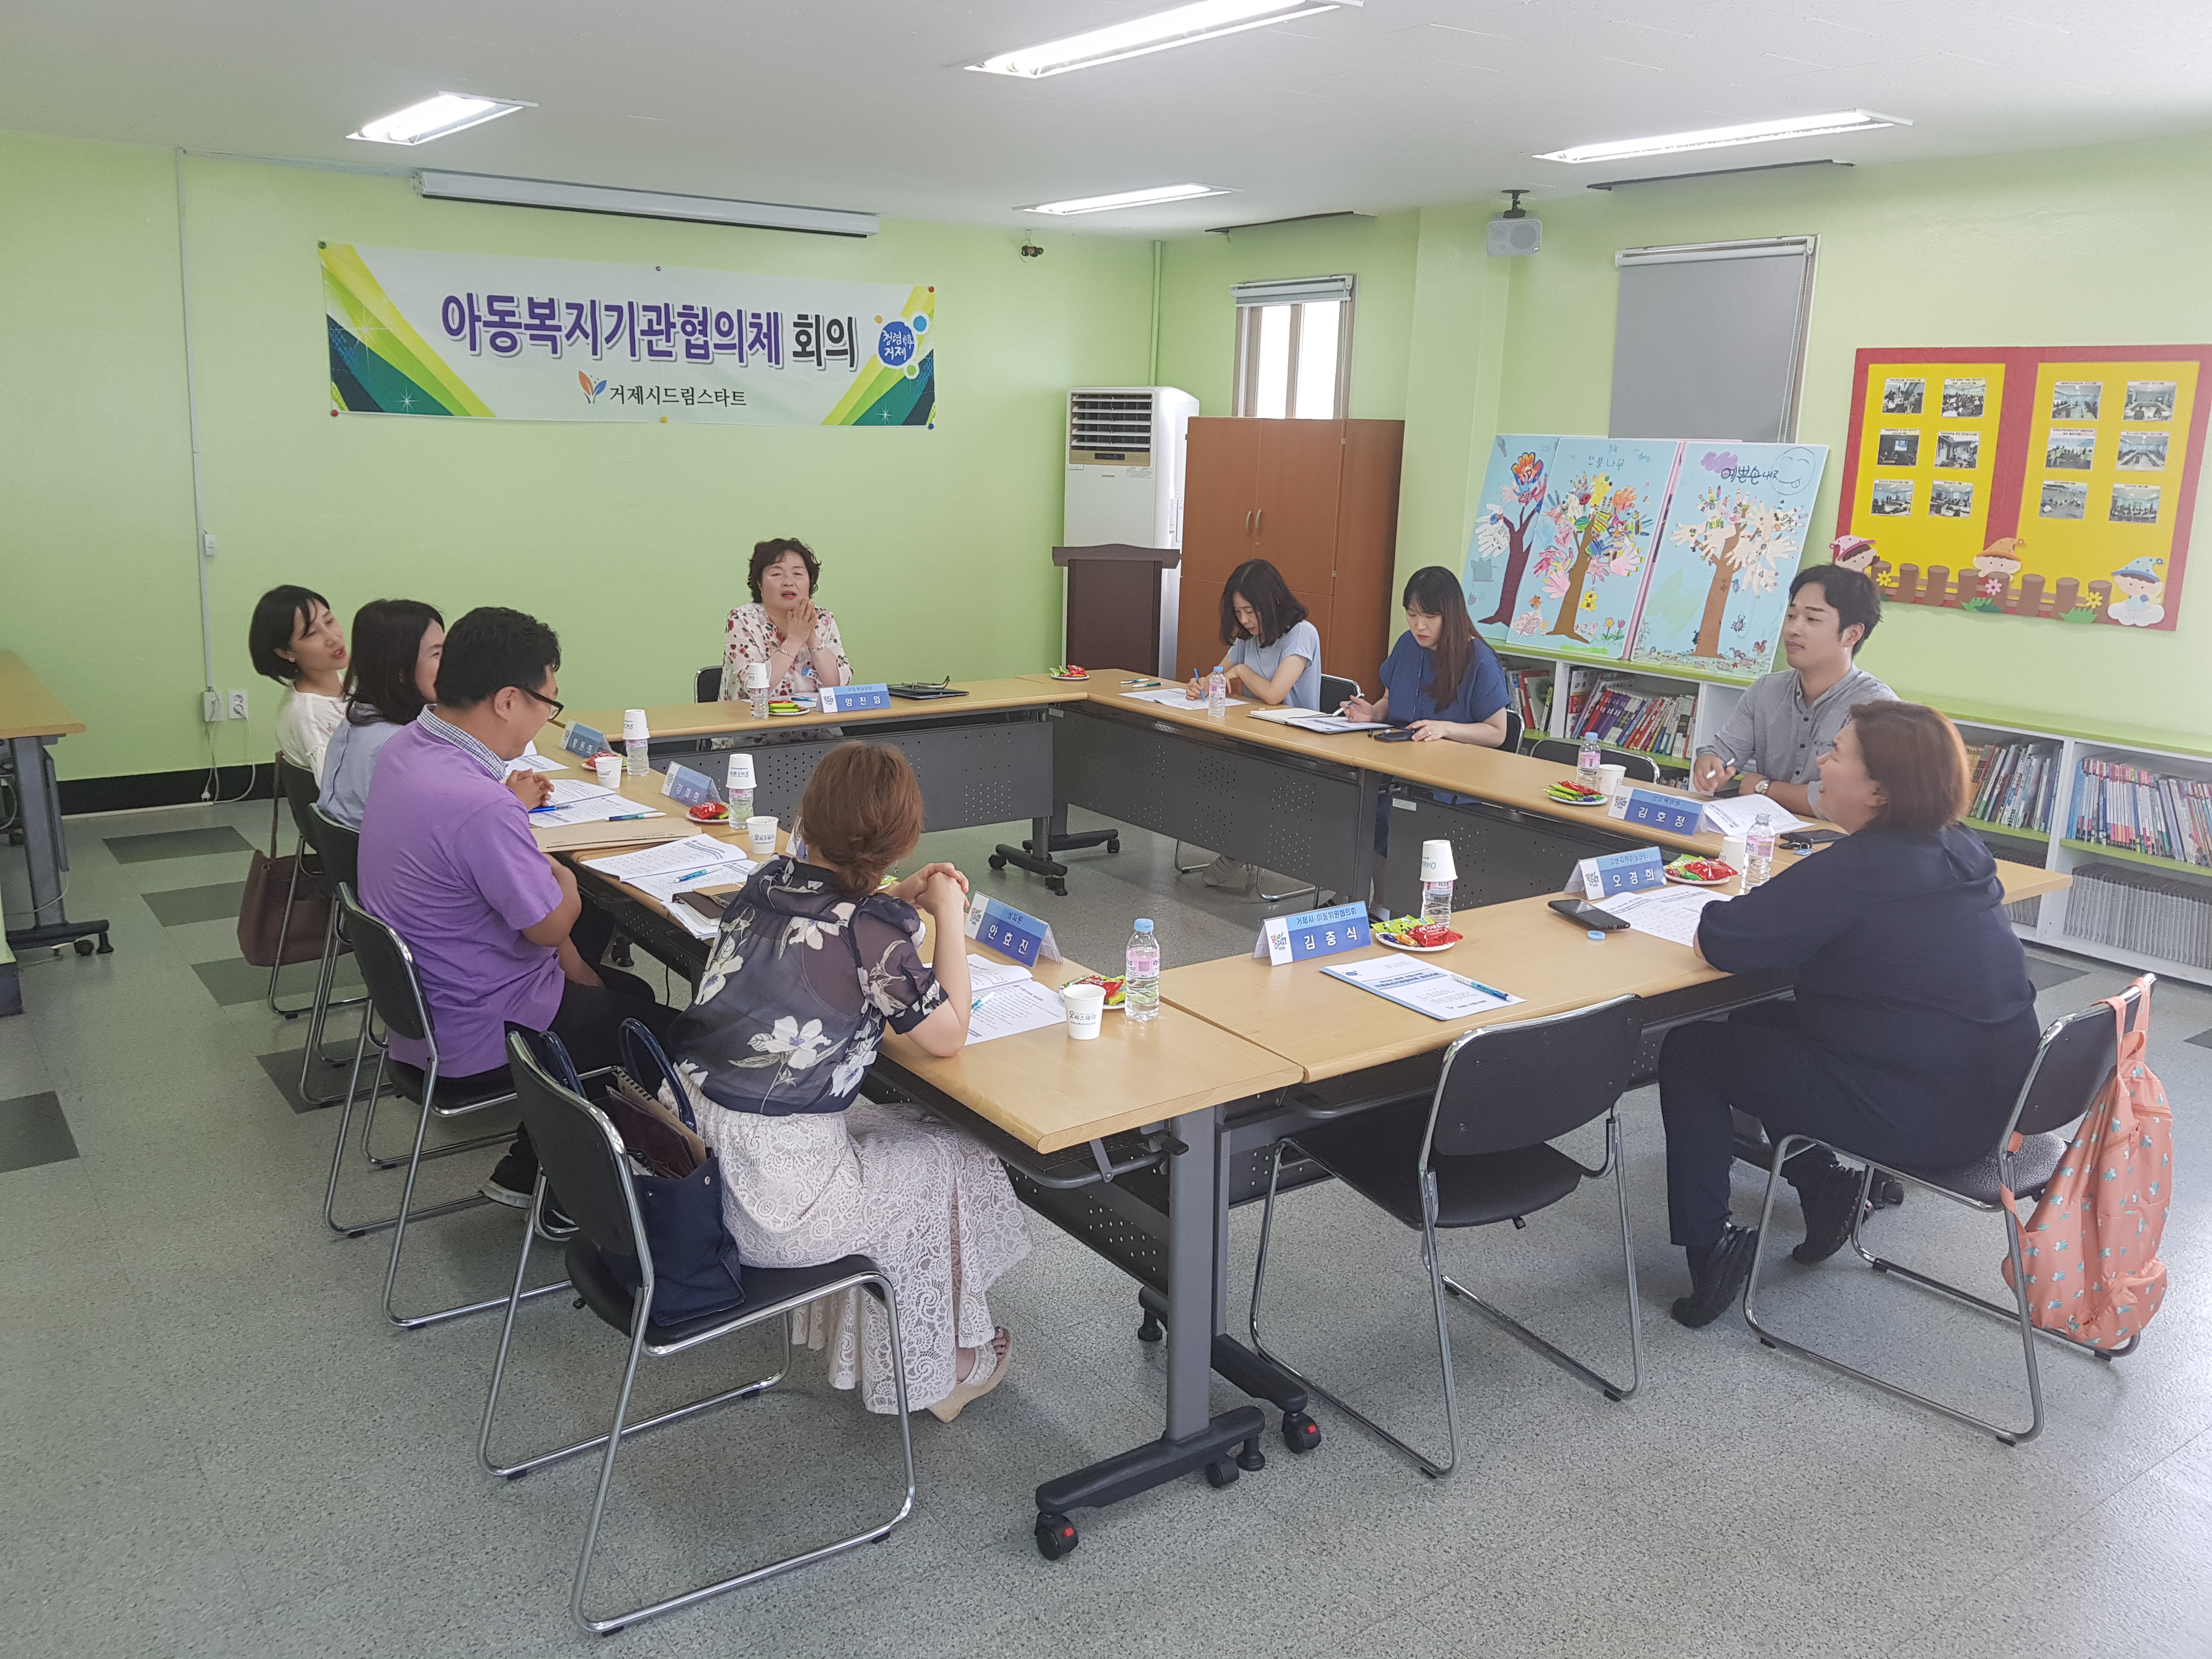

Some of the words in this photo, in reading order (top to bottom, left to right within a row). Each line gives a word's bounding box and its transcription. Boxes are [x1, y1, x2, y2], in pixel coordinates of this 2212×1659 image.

[441, 292, 781, 365] 아동복지기관협의체
[792, 313, 856, 368] 회의
[884, 346, 906, 361] 거제
[609, 385, 747, 408] 거제시드림스타트
[1296, 915, 1314, 926] 거제시
